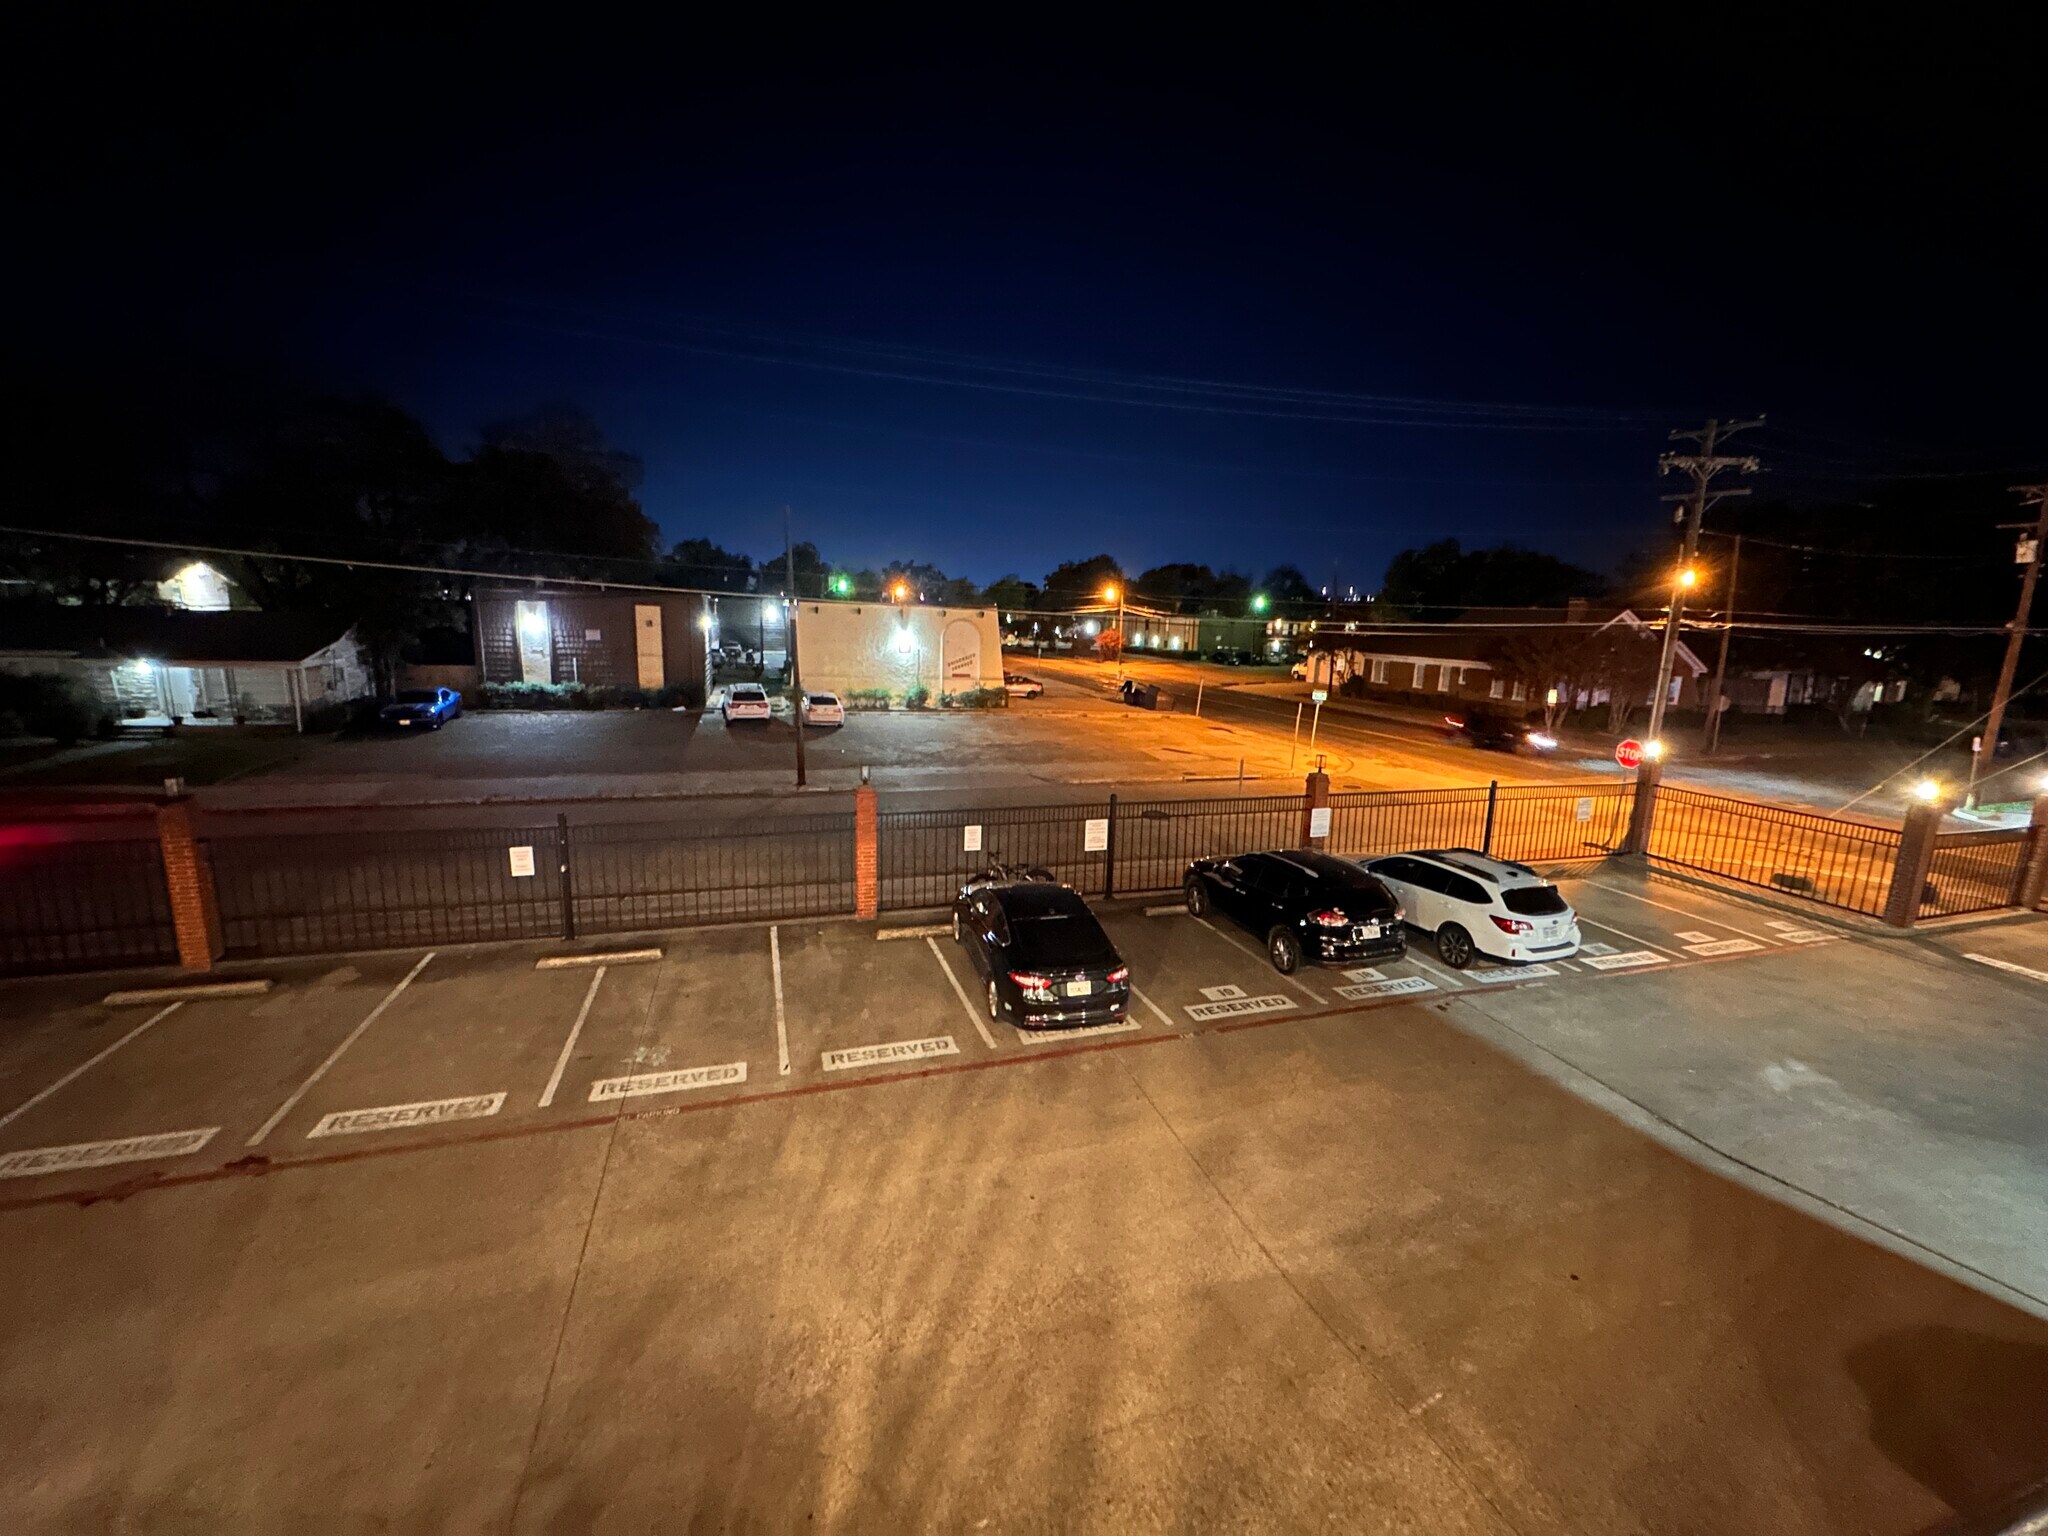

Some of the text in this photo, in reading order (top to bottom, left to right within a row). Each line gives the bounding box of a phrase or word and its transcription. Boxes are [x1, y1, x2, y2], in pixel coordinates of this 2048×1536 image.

[1618, 747, 1643, 760] STOP
[1342, 978, 1426, 998] RESERVED
[1192, 997, 1287, 1017] RESERVED
[831, 1039, 950, 1065] RESERVED
[600, 1066, 739, 1095] RESERVED
[327, 1098, 496, 1131] RESERVED
